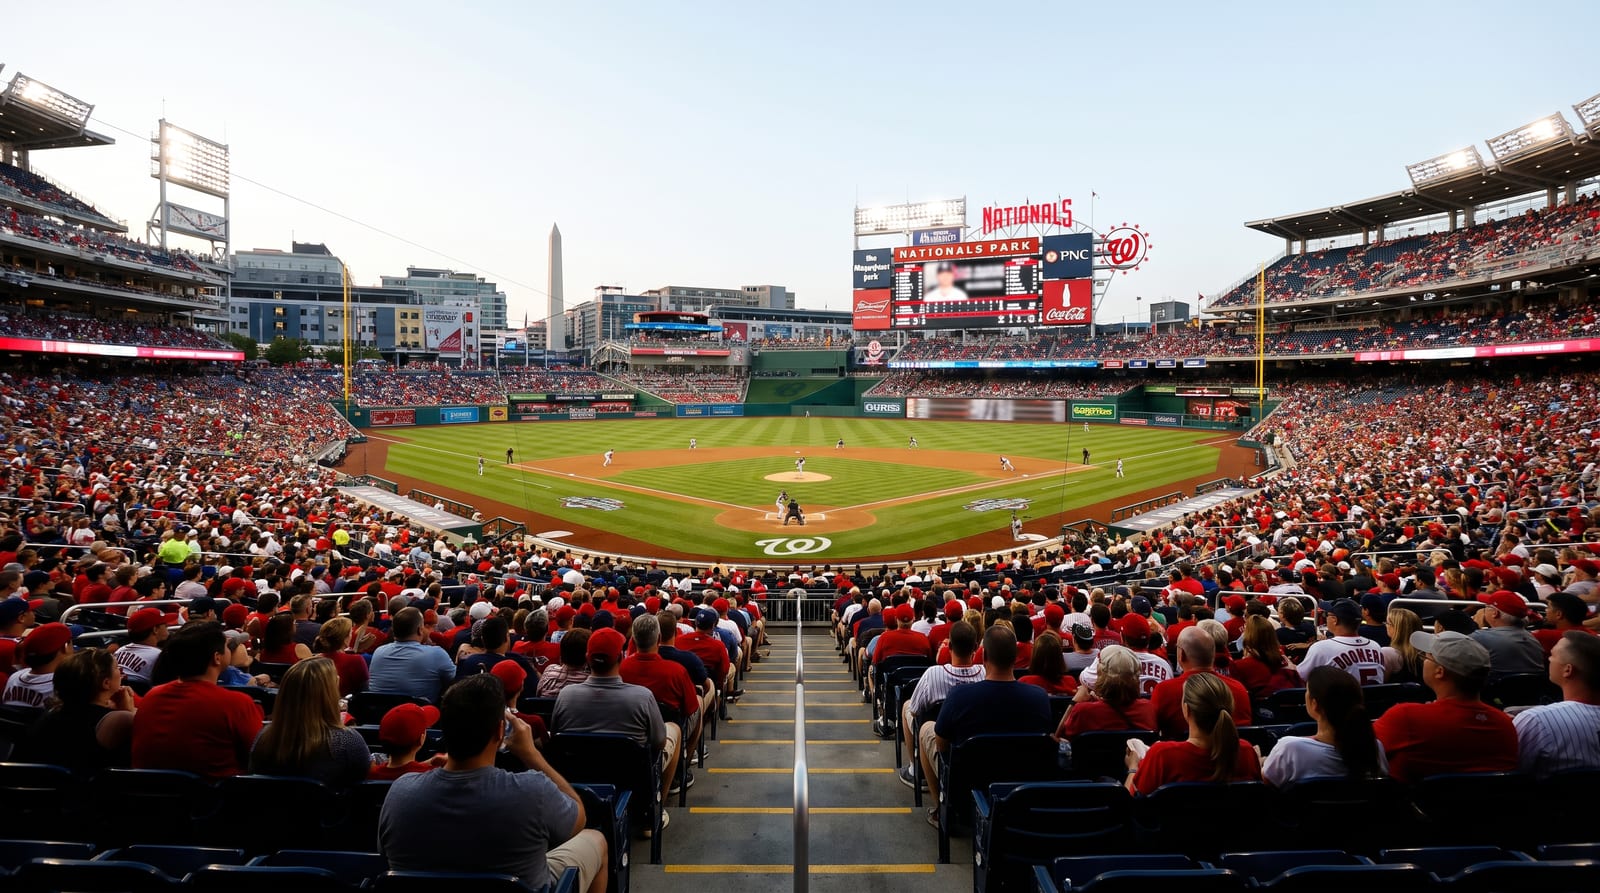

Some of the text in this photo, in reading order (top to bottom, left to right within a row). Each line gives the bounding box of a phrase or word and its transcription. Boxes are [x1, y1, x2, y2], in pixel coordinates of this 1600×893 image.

[983, 198, 1072, 235] NATIONALS
[899, 241, 1031, 260] NATIONALS PARK
[1060, 249, 1089, 261] PNC
